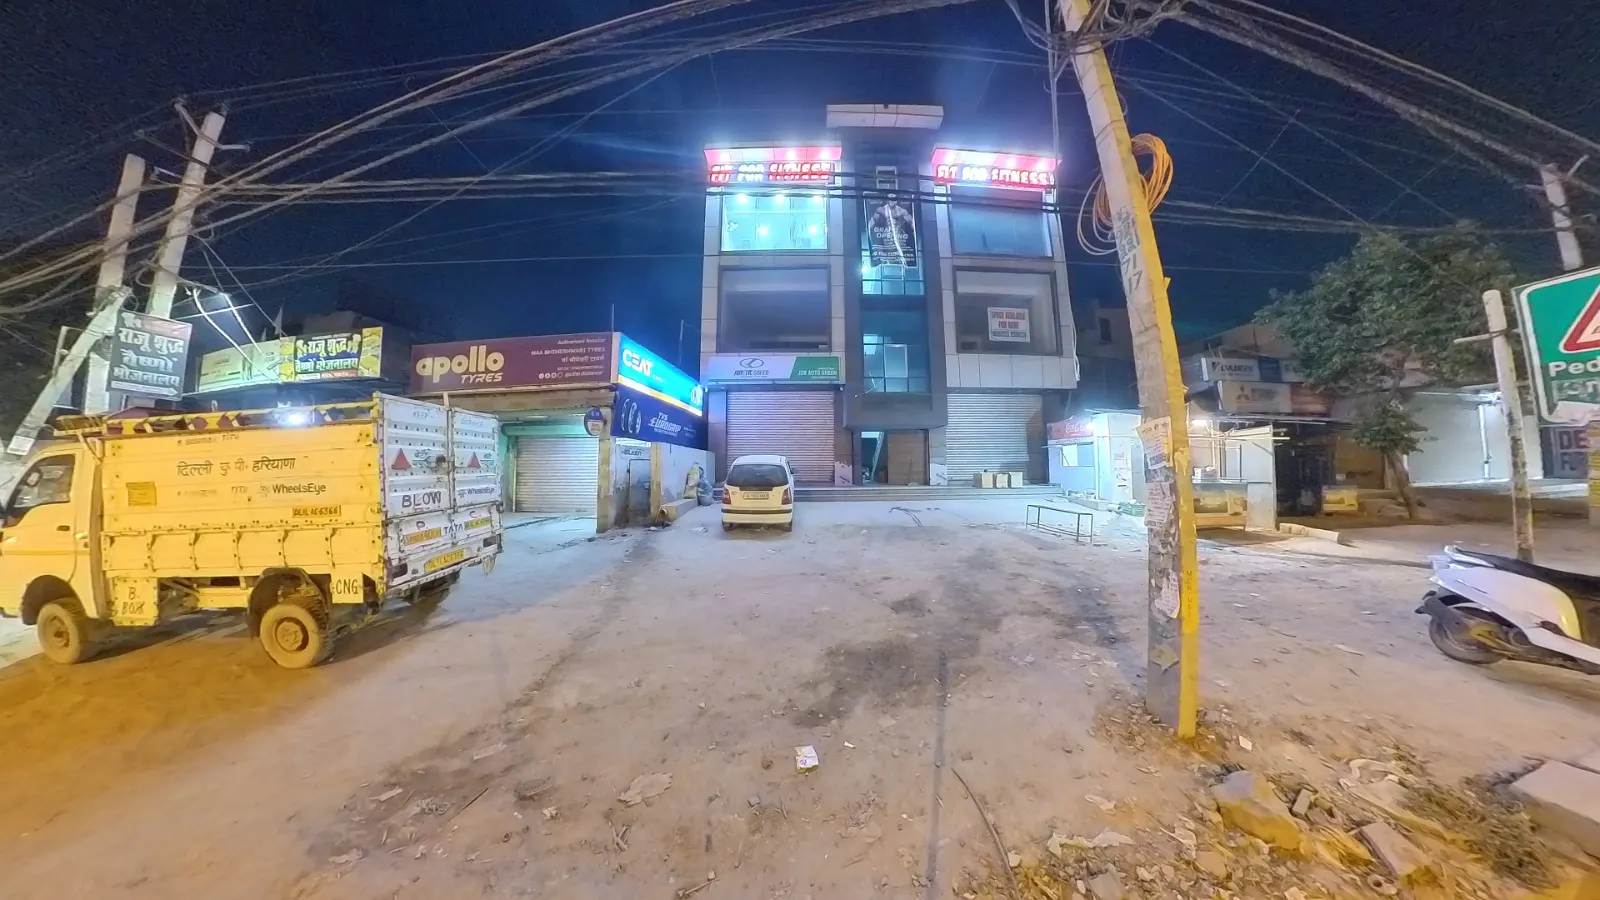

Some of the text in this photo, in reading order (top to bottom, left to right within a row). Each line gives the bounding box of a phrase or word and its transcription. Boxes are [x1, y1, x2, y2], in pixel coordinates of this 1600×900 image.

[118, 327, 151, 352] राजू
[415, 345, 504, 383] apollo
[622, 348, 653, 377] CEAT
[461, 371, 503, 384] TYRES
[272, 482, 327, 495] WheelsEye
[402, 491, 442, 508] BLOW
[444, 523, 463, 536] TATA
[335, 579, 359, 595] CNG
